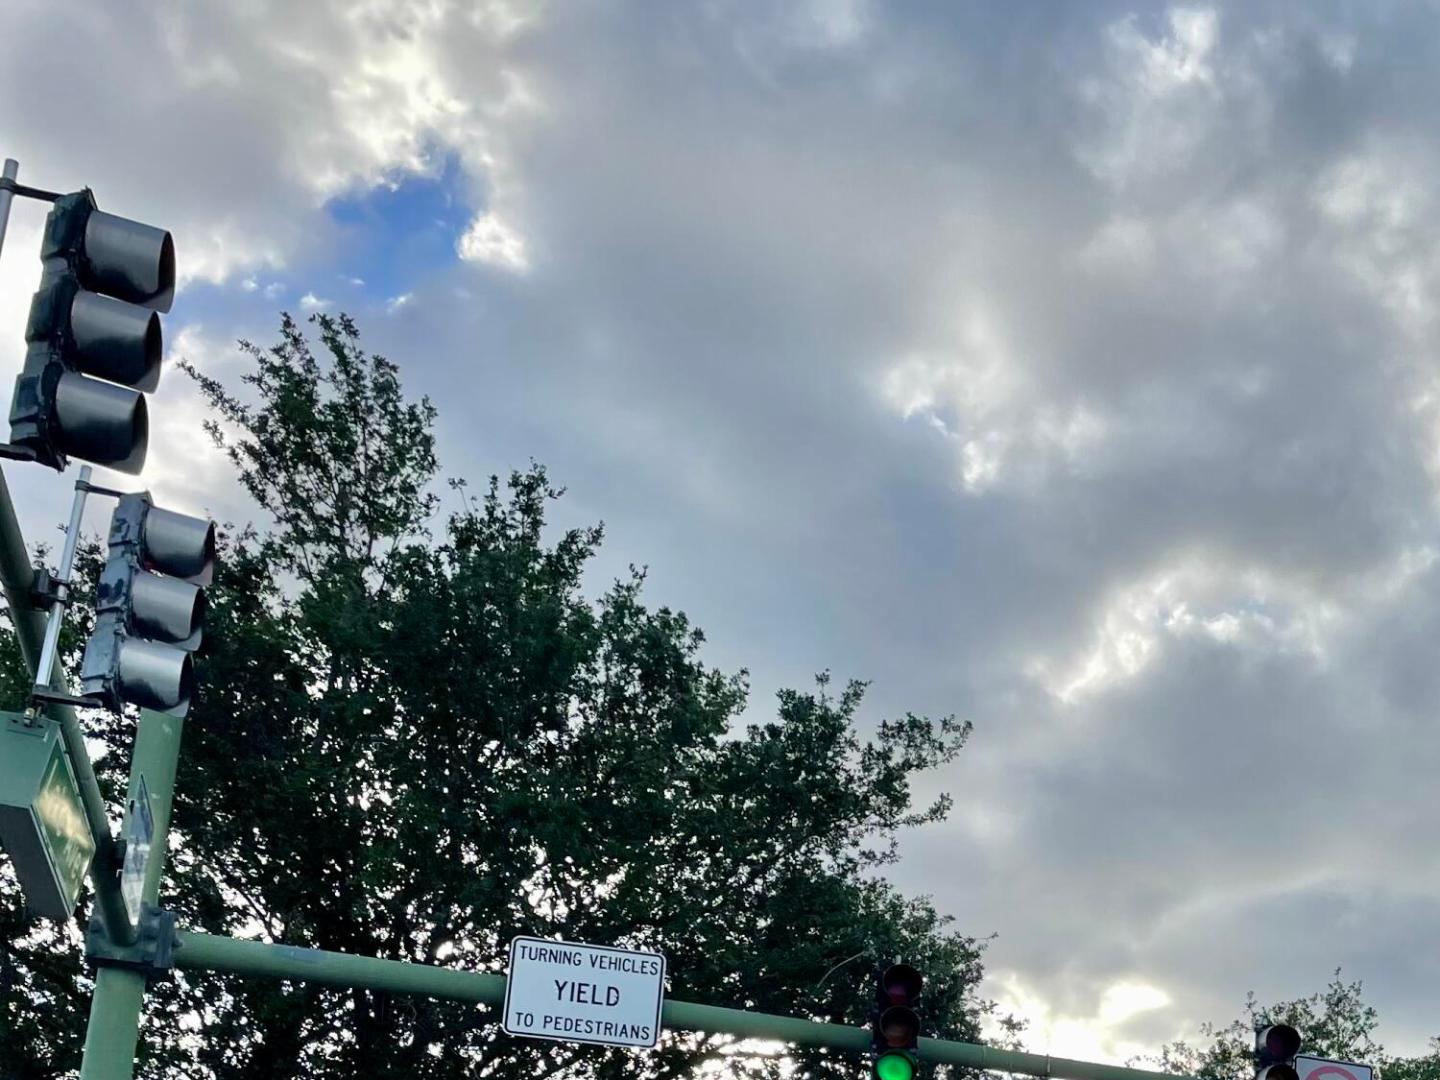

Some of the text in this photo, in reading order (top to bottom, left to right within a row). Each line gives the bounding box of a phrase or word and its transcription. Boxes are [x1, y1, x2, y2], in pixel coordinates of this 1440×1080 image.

[519, 945, 659, 976] TURNING VEHICLES
[554, 979, 620, 1007] YIELD
[515, 1012, 650, 1040] TO PEDESTRIANS
